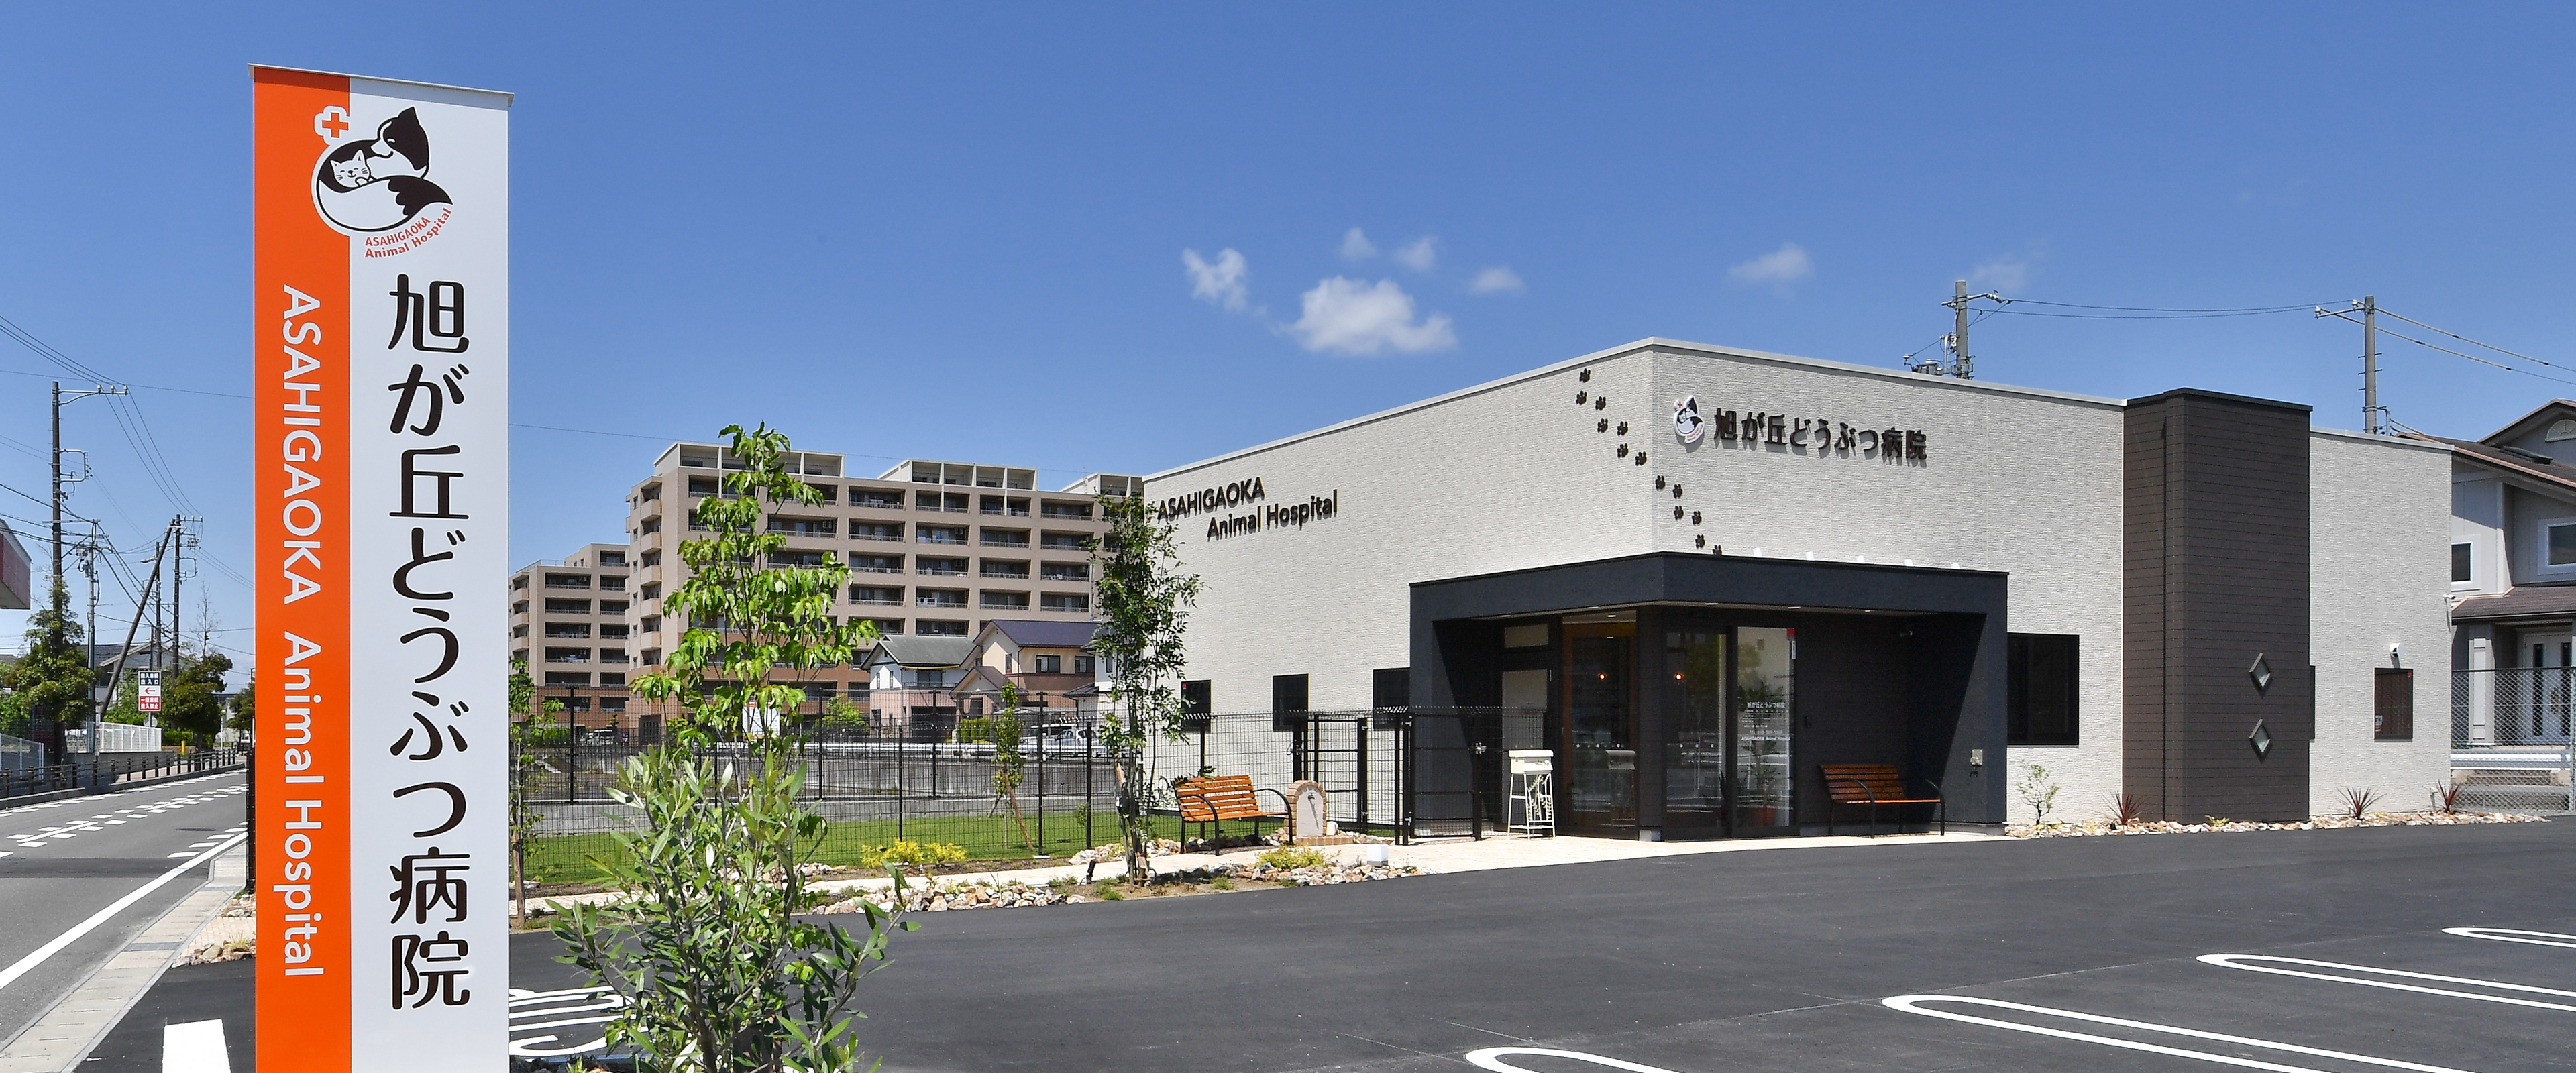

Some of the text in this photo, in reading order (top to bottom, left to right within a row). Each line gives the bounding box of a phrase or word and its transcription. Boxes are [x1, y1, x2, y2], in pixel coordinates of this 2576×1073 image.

[365, 217, 431, 247] ASAHIGAOKA
[365, 207, 451, 258] Animal Hospital
[1714, 407, 1927, 460] 旭が丘どうぶつ病院
[1157, 477, 1265, 520] ASAHIGAOKA
[1208, 489, 1338, 538] Animal Hospital
[273, 284, 325, 976] ASAHIGAOKA Animal Hospital
[388, 273, 470, 1011] 旭が丘どうぶつ病院
